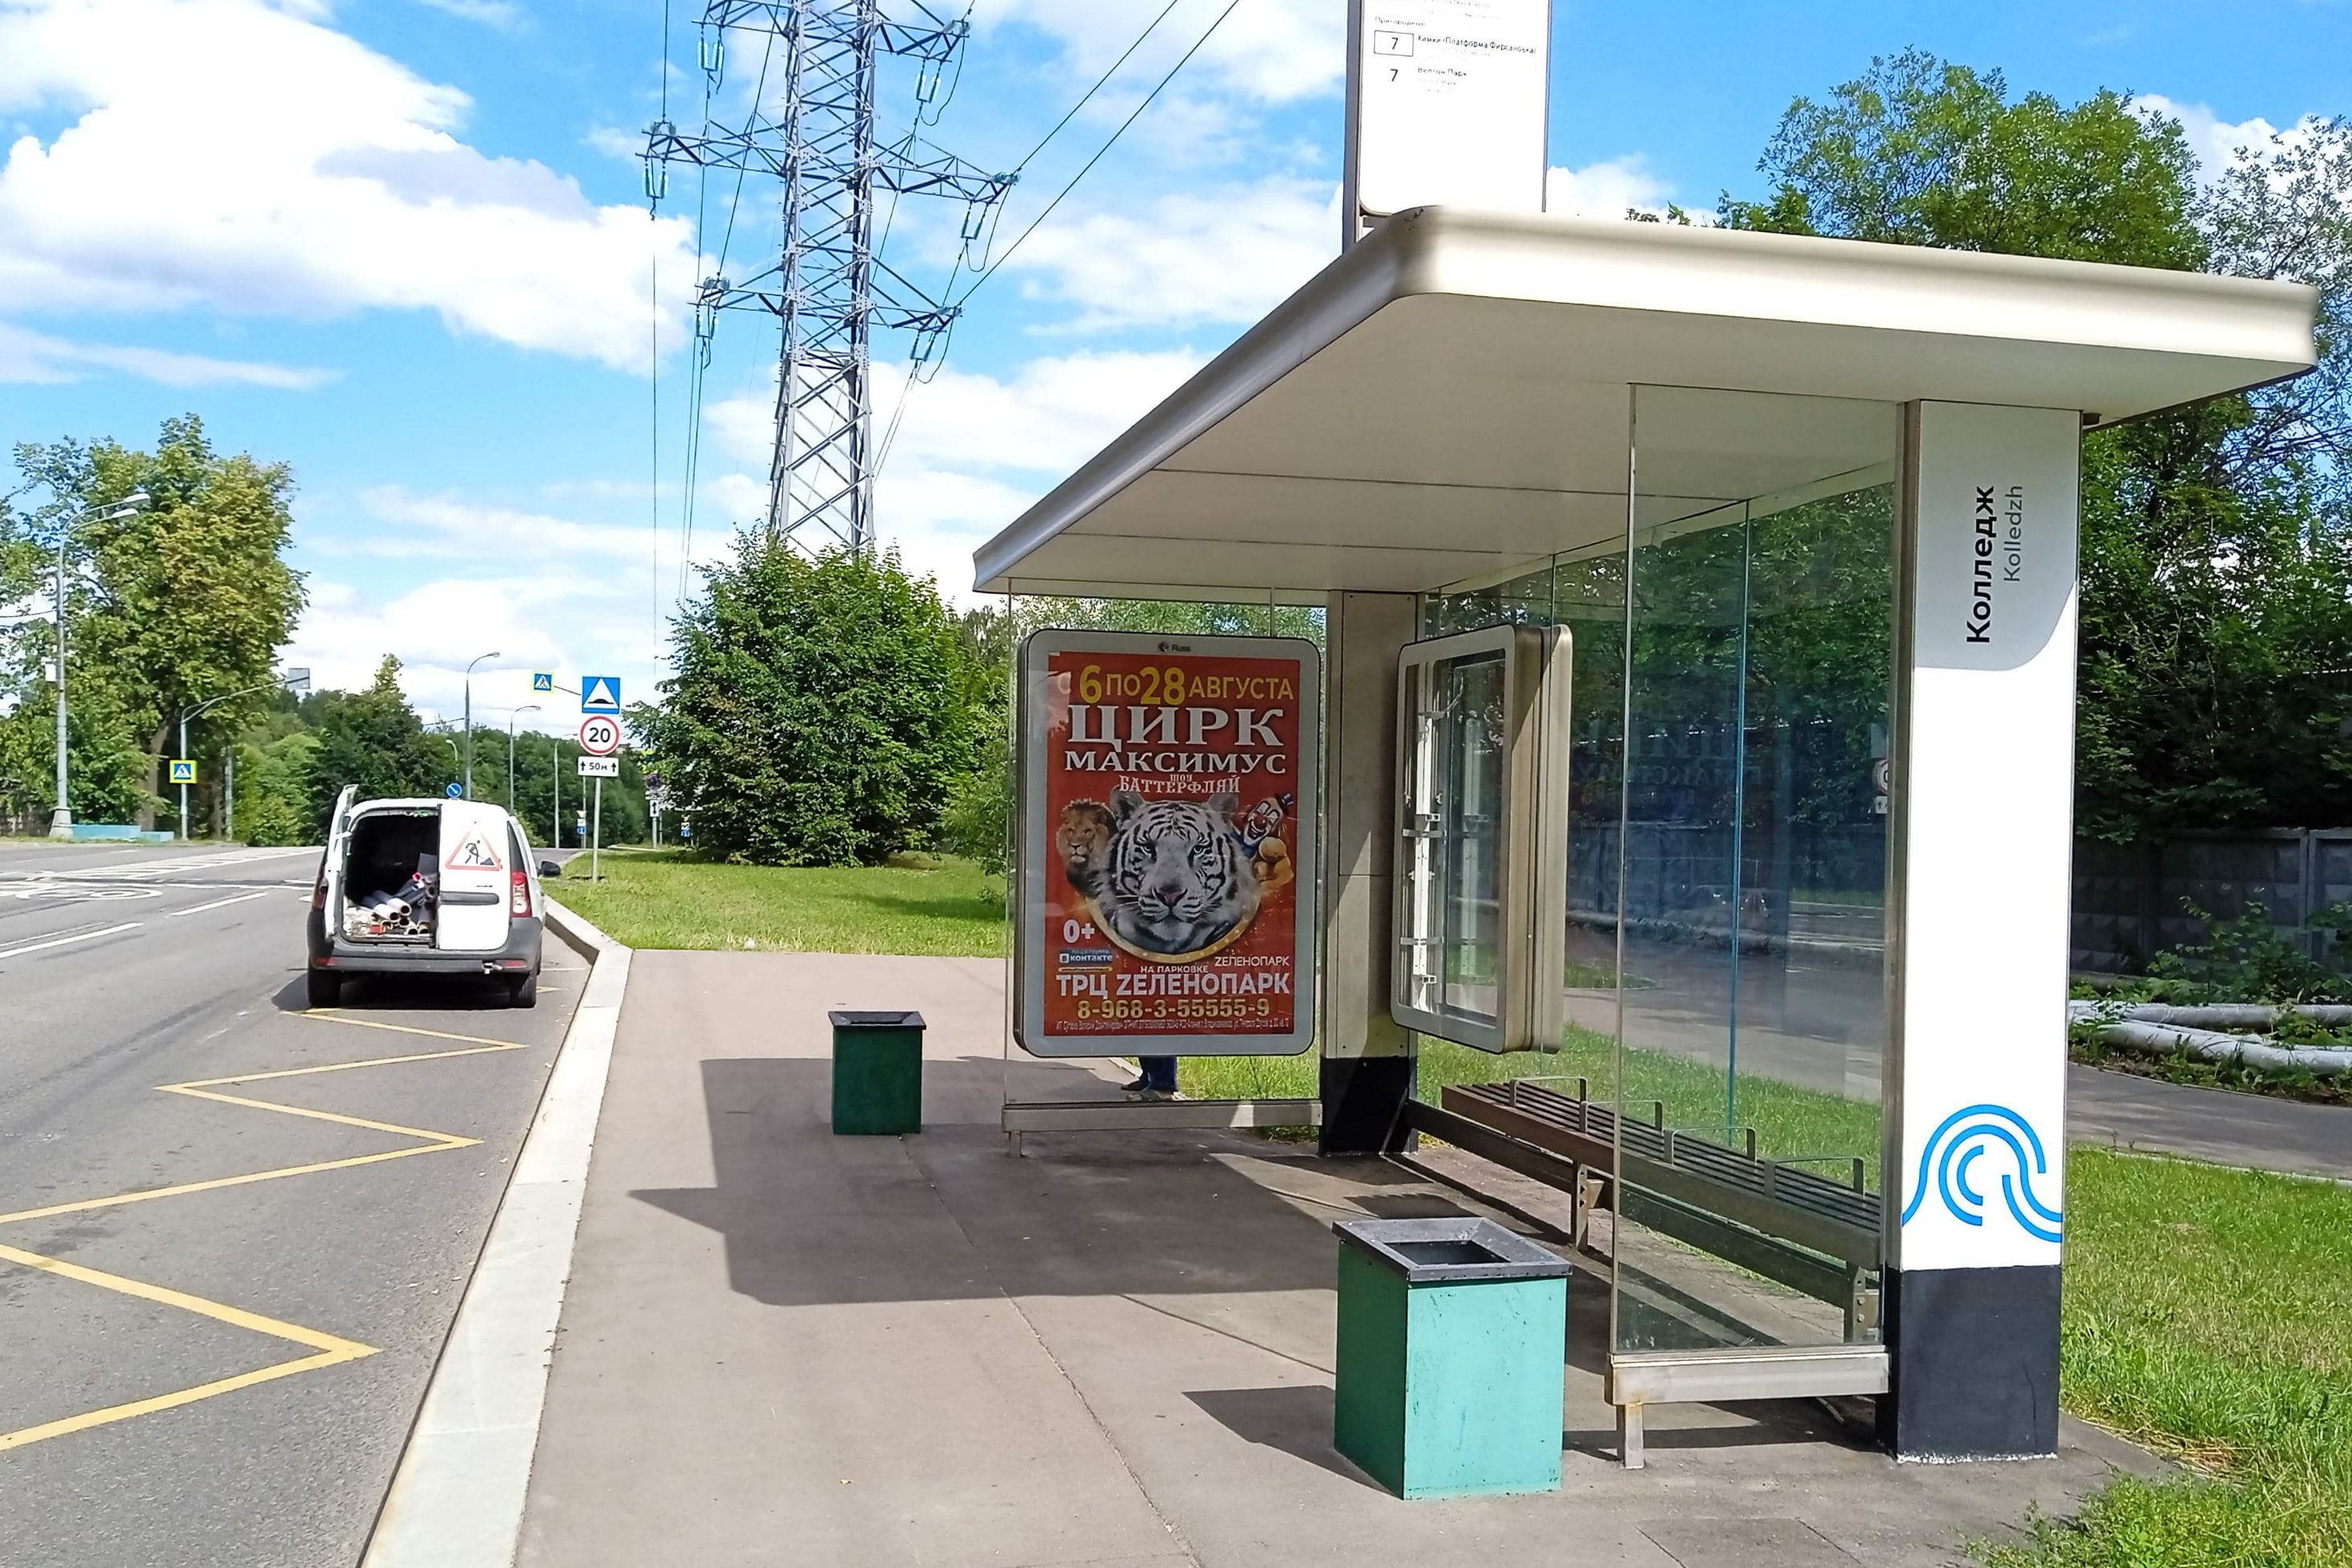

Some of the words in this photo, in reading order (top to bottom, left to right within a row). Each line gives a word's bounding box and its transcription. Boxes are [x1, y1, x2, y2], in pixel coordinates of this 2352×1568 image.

[1390, 37, 1399, 50] 7
[1390, 68, 1399, 82] 7
[2003, 485, 2023, 582] Kolledzh
[1966, 485, 1997, 643] Колледж
[1080, 664, 1103, 704] 6
[1105, 672, 1141, 696] ПО
[1140, 666, 1186, 706] 28
[1188, 676, 1294, 700] АВГУСТА
[588, 727, 610, 743] 20
[1068, 704, 1284, 753] ЦИРК
[1064, 750, 1286, 774] МАКСИМУС
[1119, 774, 1241, 794] БАТТЕРФЛЯЙ
[1170, 774, 1193, 782] ШОУ
[1062, 919, 1096, 944] 0+
[1140, 965, 1154, 974] НА
[1157, 965, 1209, 974] ПАРКОВКЕ
[1056, 974, 1109, 998] ТРЦ
[1077, 998, 1271, 1019] 8-968-3-55555-9
